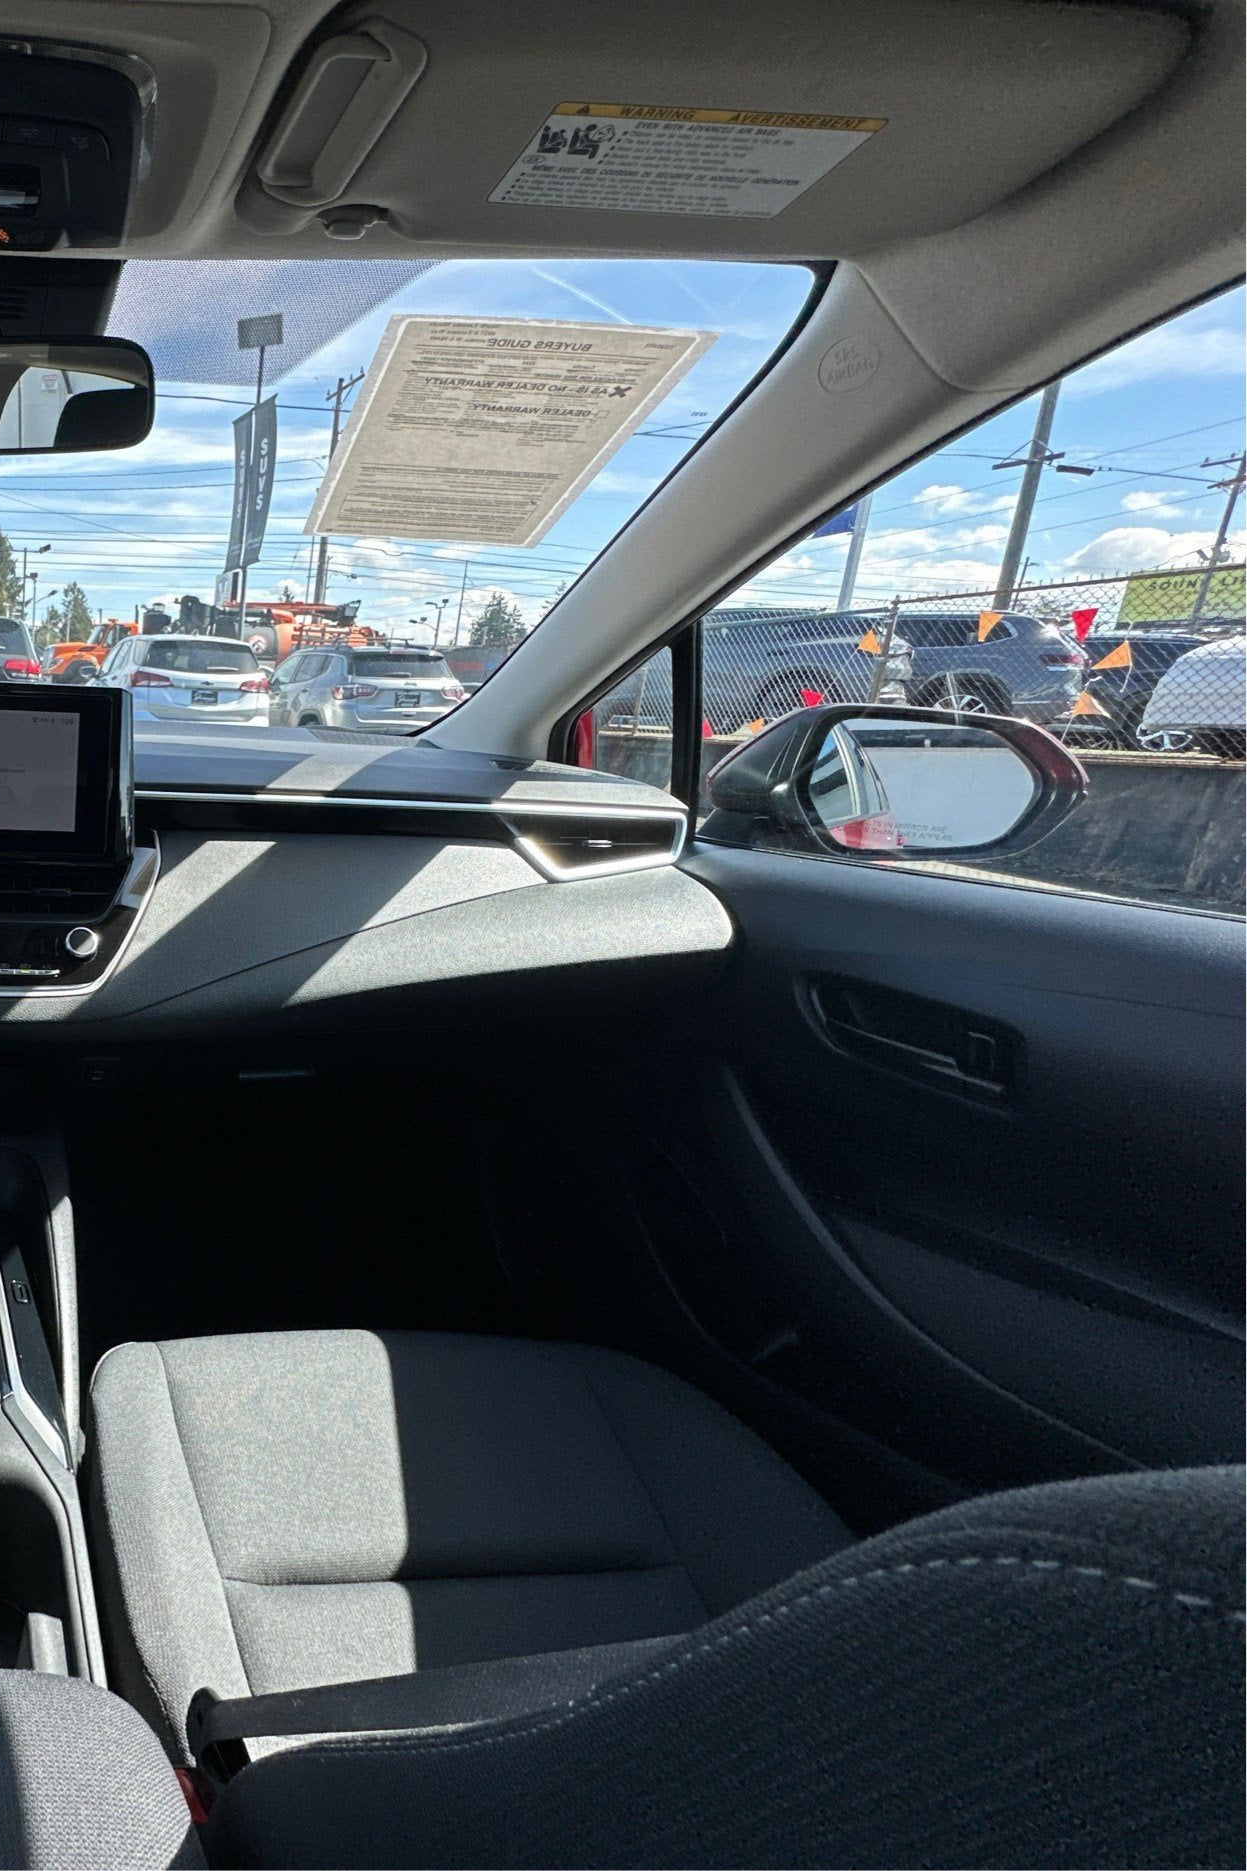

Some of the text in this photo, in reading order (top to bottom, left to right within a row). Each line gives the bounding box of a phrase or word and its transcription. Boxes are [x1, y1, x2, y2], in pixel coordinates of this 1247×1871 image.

[620, 106, 697, 120] WARNING
[727, 112, 865, 130] AVERTISSEMENT
[255, 437, 269, 511] SUVS
[1147, 578, 1201, 591] SOUN
